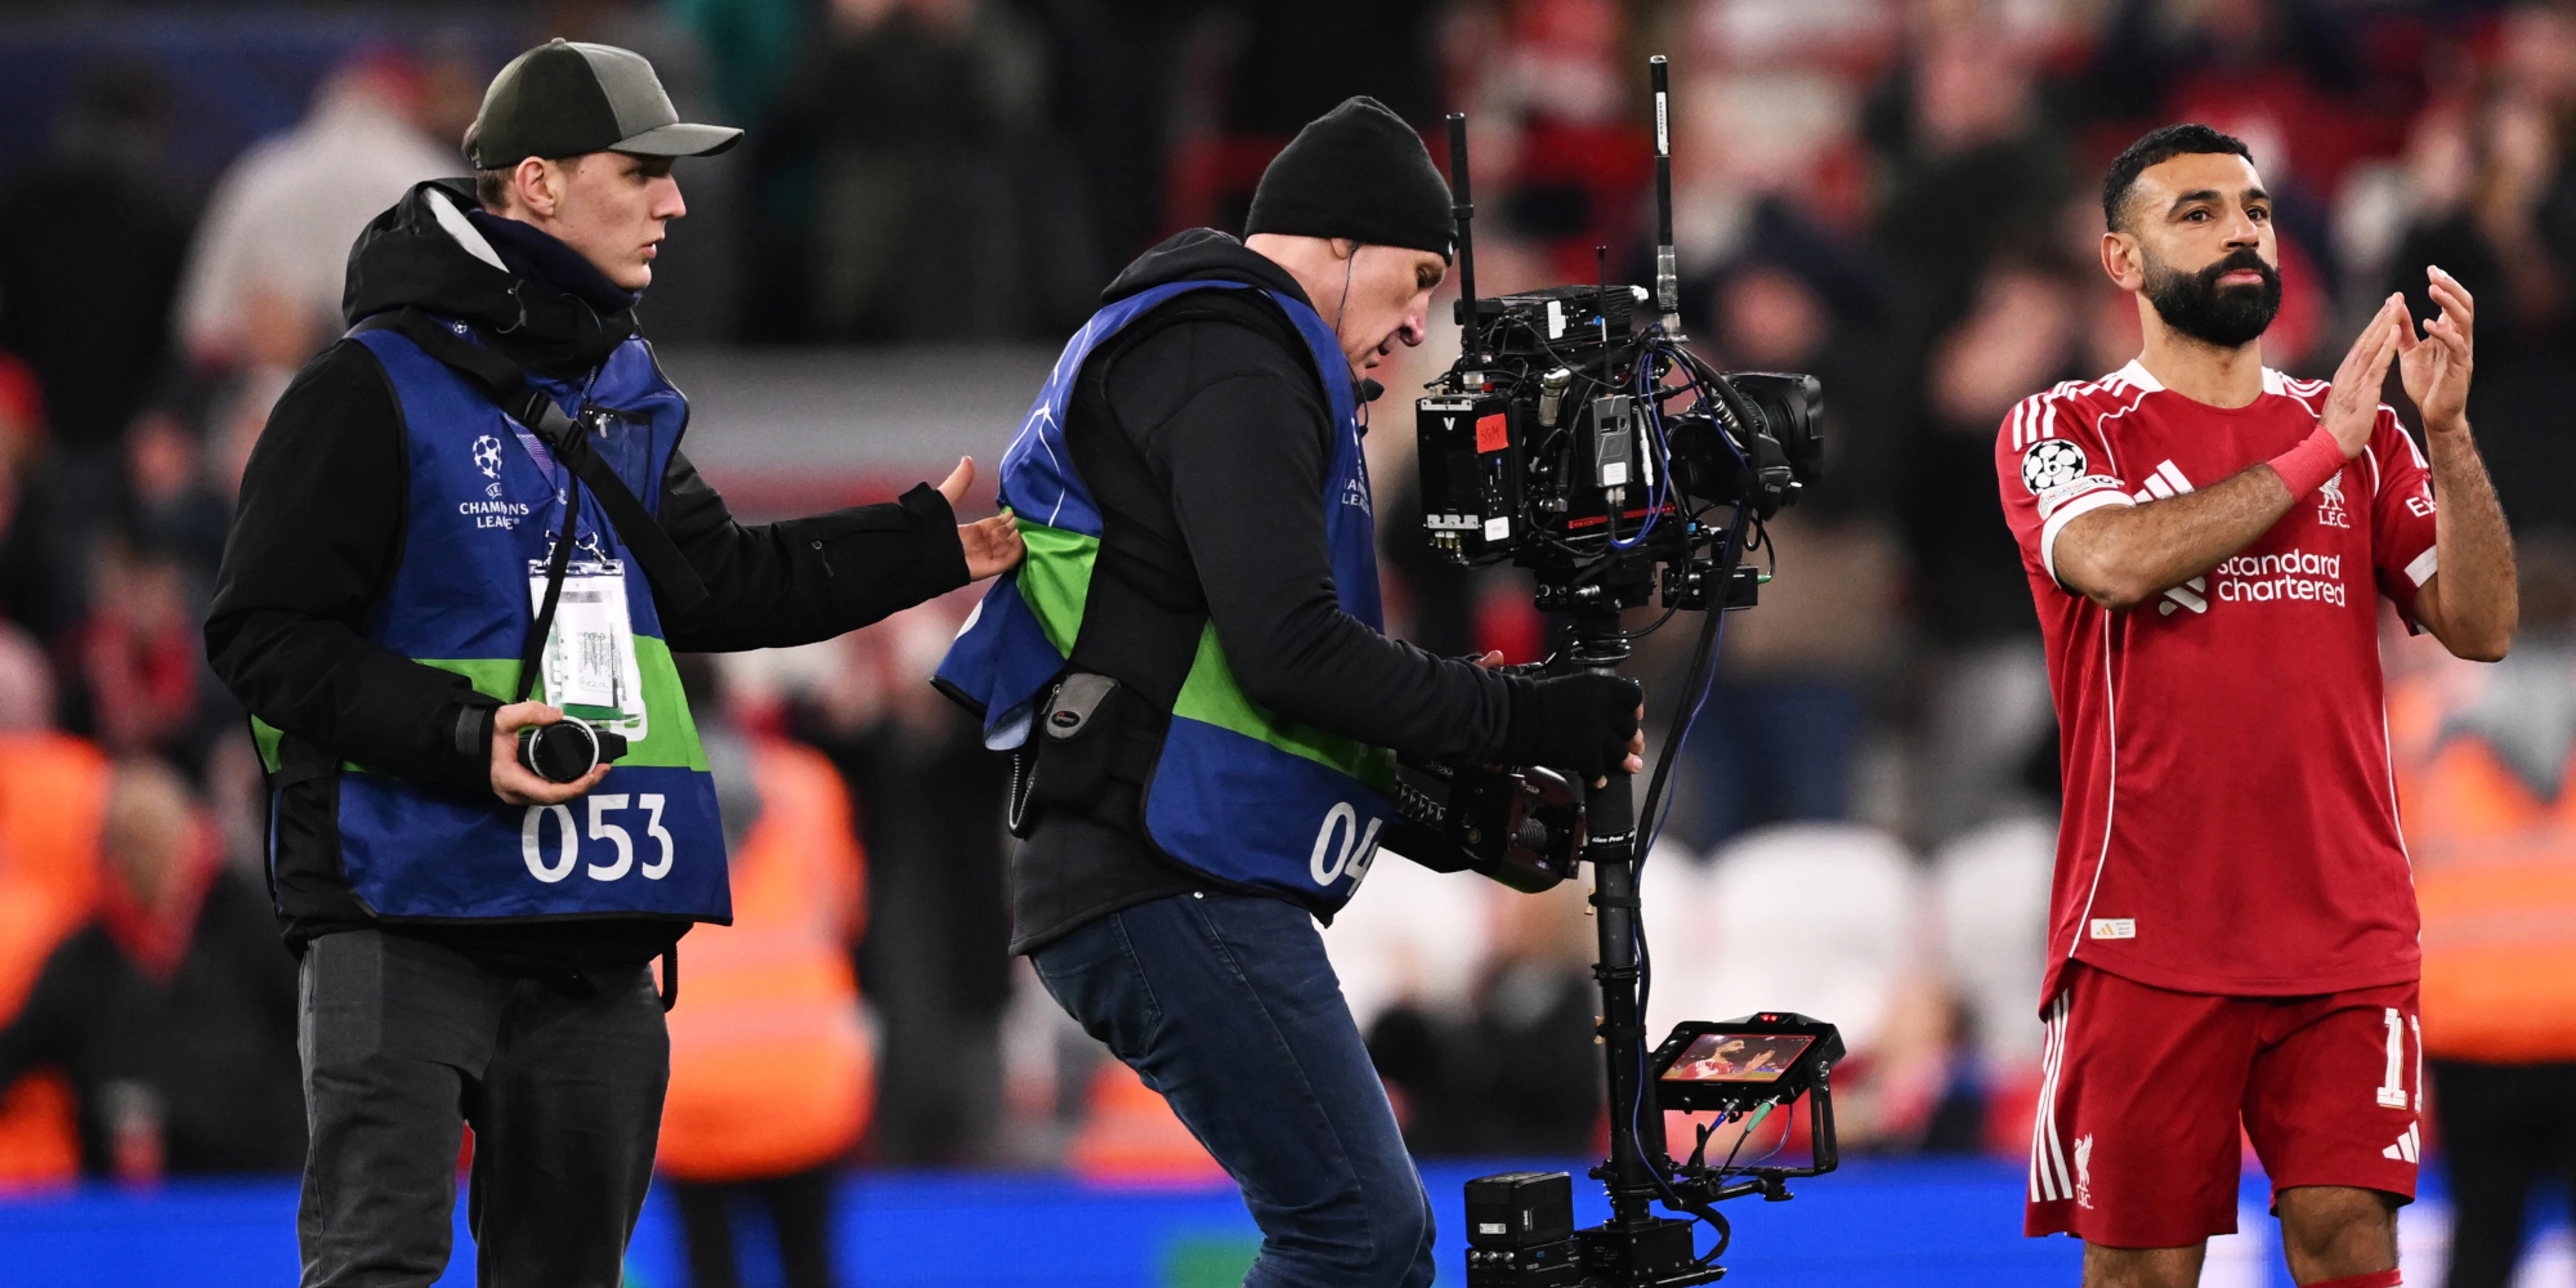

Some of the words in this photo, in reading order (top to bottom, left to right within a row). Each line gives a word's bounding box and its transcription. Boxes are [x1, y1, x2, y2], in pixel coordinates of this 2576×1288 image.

[486, 483, 502, 499] UE
[476, 515, 513, 530] LEAE
[2318, 510, 2350, 529] L.F.C.
[2218, 574, 2346, 608] chartered
[522, 794, 674, 883] 053
